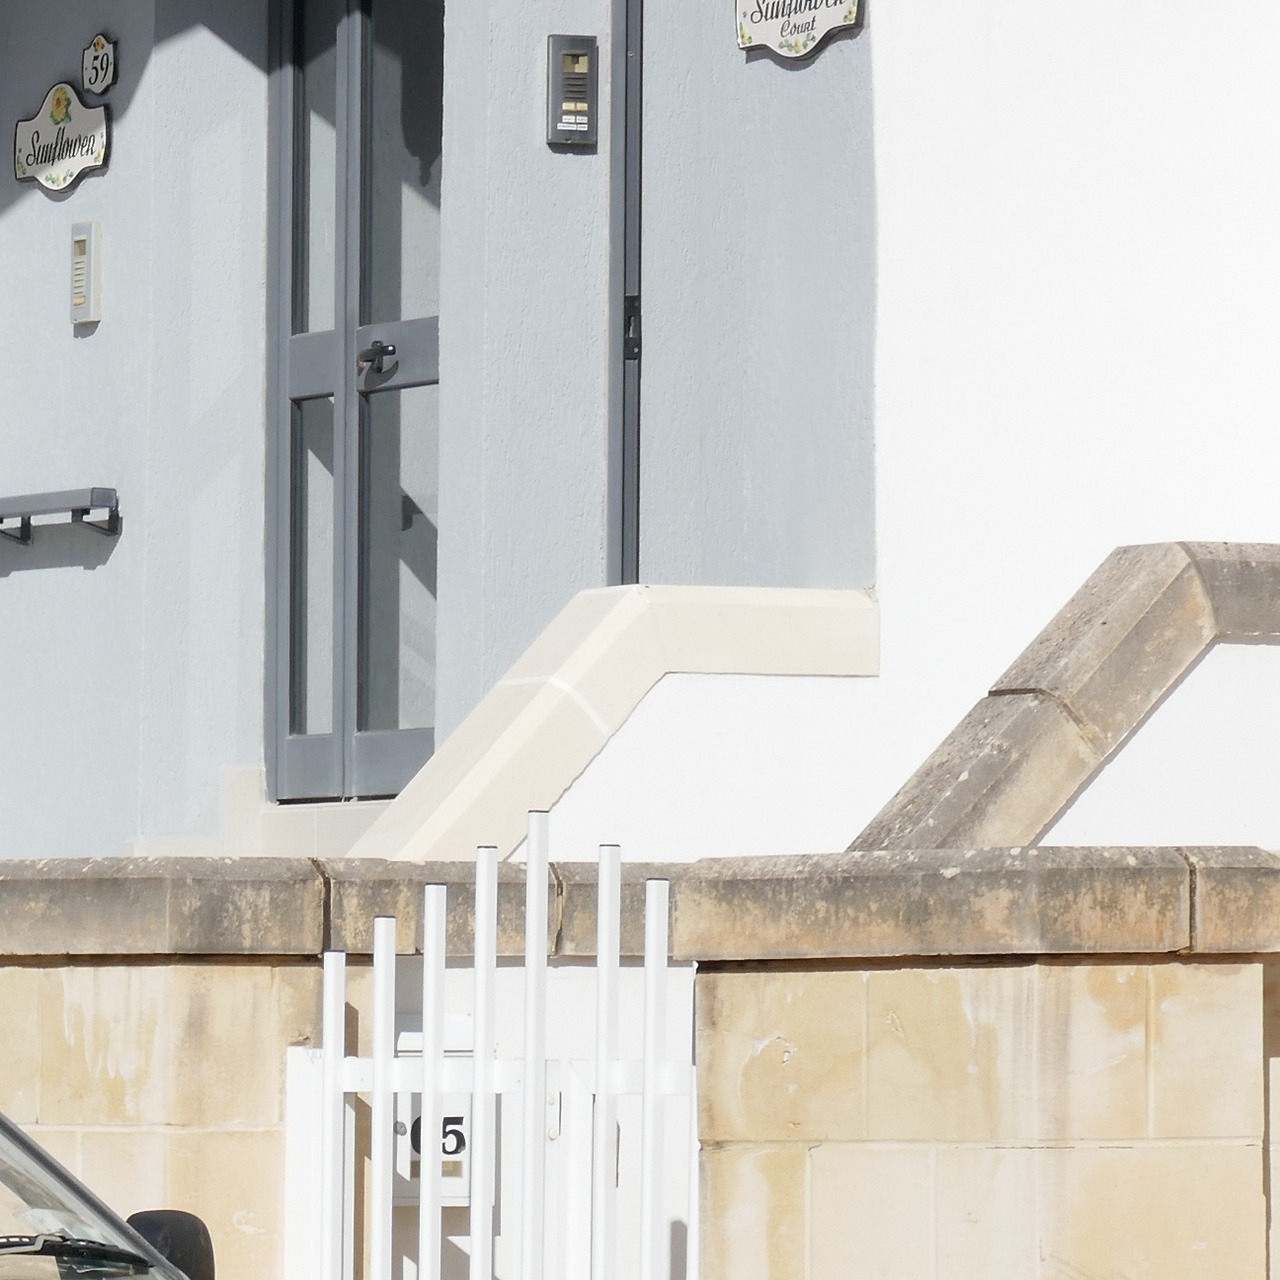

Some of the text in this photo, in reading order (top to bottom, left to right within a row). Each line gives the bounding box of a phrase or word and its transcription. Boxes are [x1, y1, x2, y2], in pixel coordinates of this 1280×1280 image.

[780, 15, 817, 38] Court
[88, 52, 110, 86] 59
[25, 126, 97, 167] Sunflower
